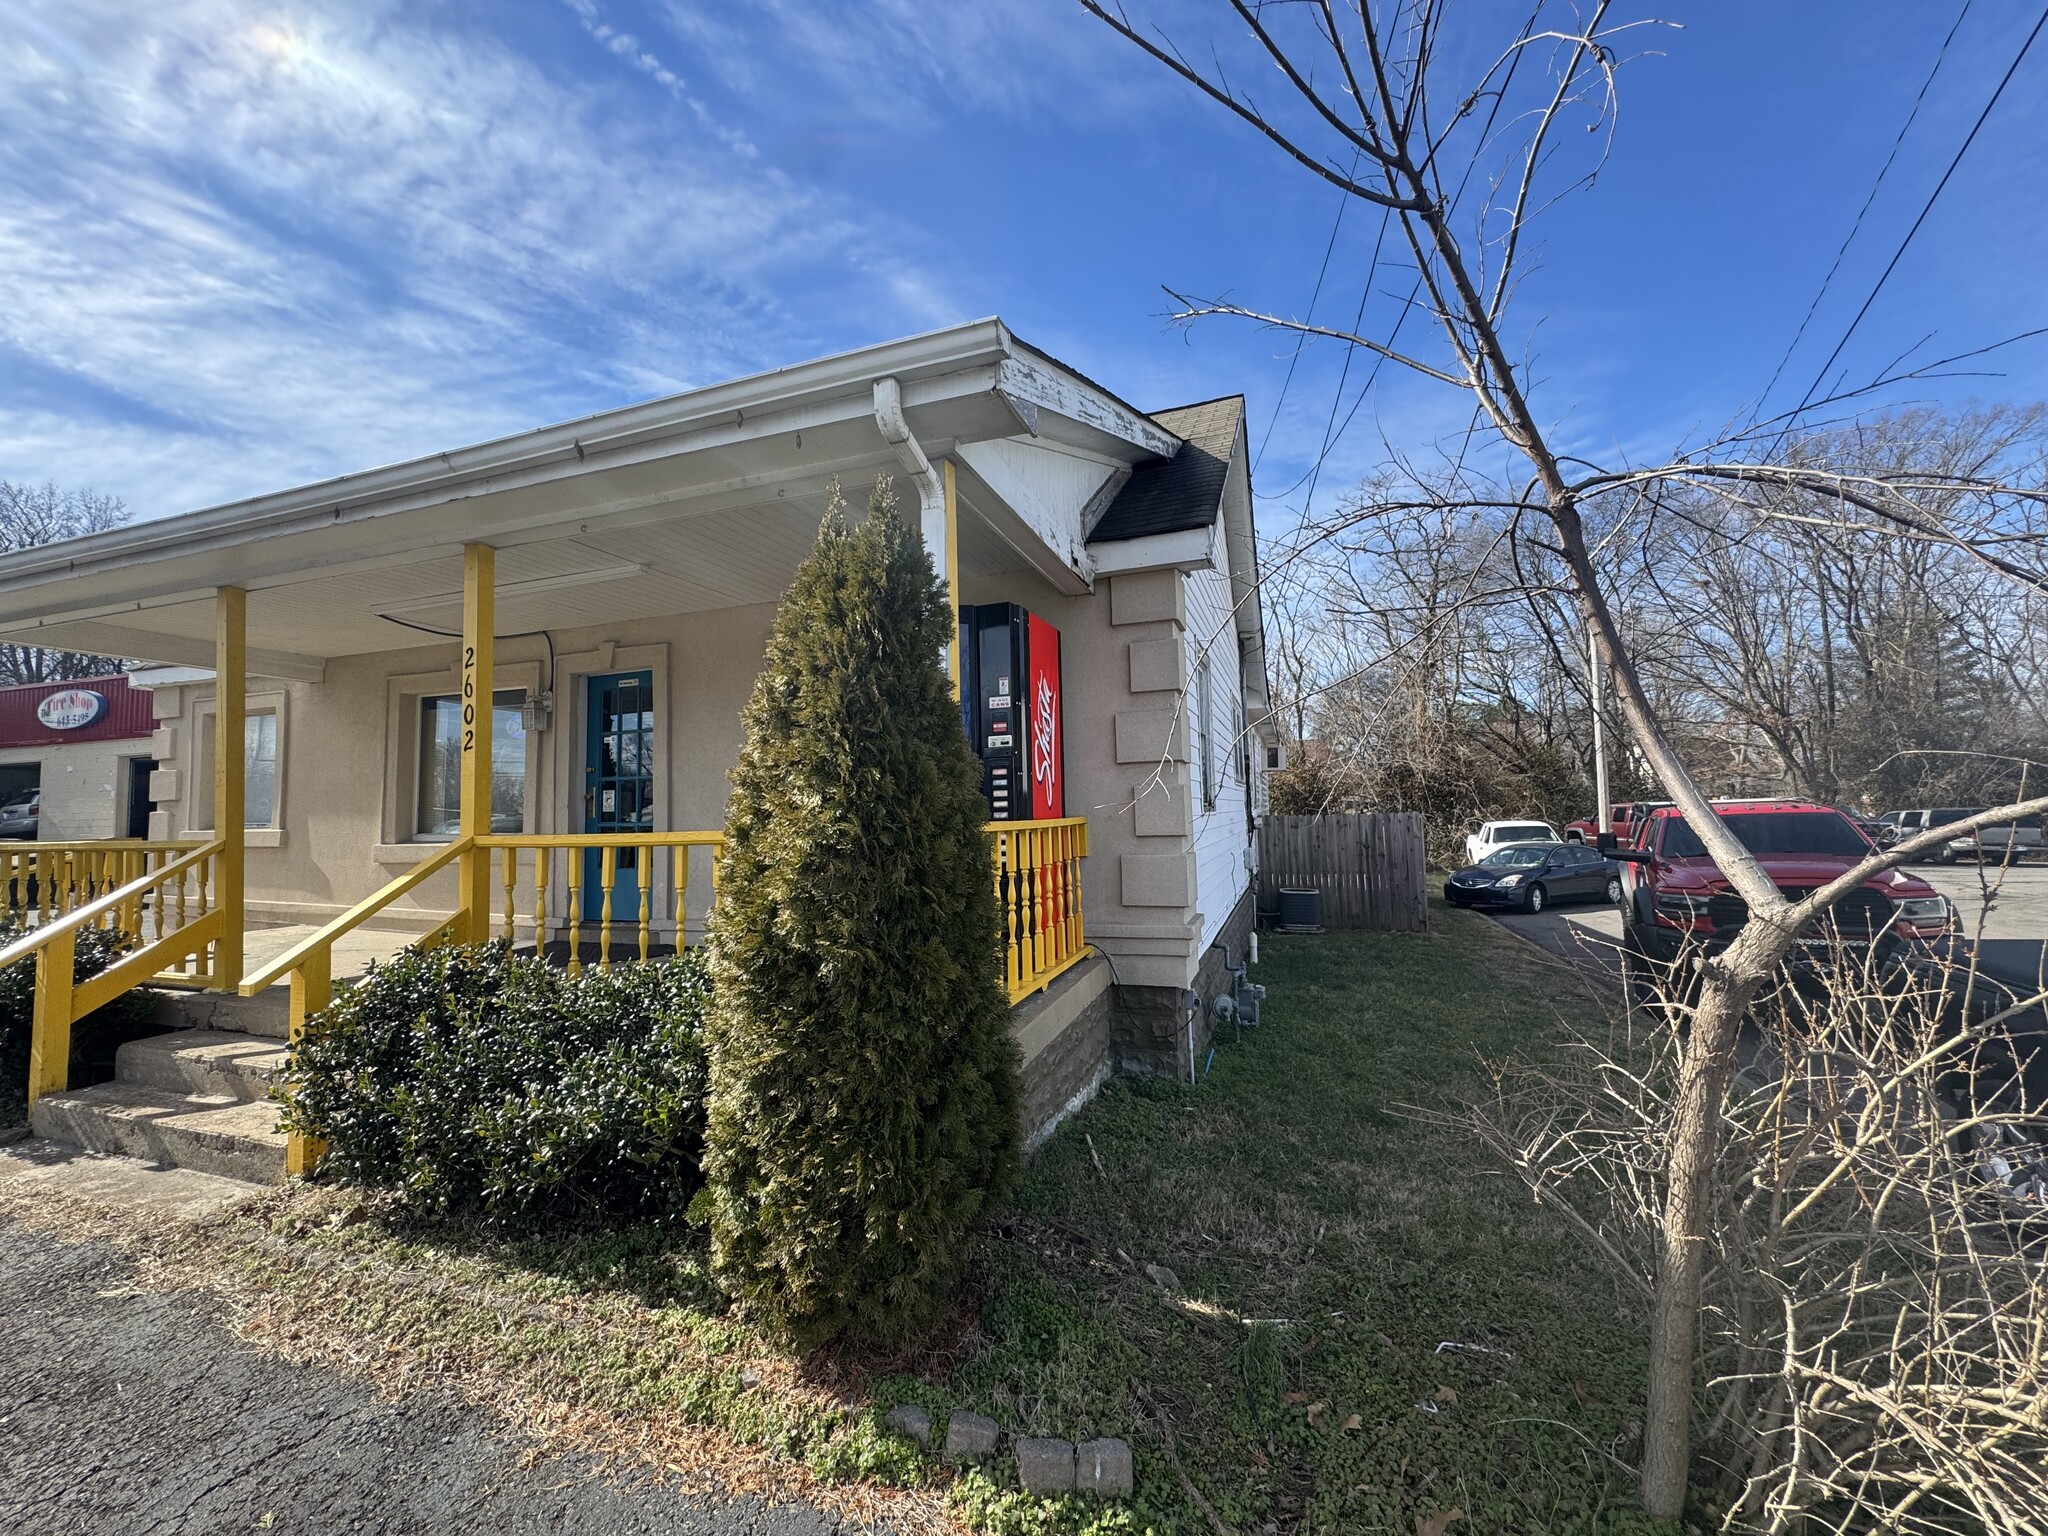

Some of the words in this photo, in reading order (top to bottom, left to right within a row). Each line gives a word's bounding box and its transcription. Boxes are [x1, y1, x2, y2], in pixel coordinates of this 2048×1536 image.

[45, 697, 67, 712] Tire
[69, 692, 93, 711] Shop
[463, 647, 475, 752] 2602
[41, 708, 51, 718] The
[1034, 669, 1057, 807] Shasta
